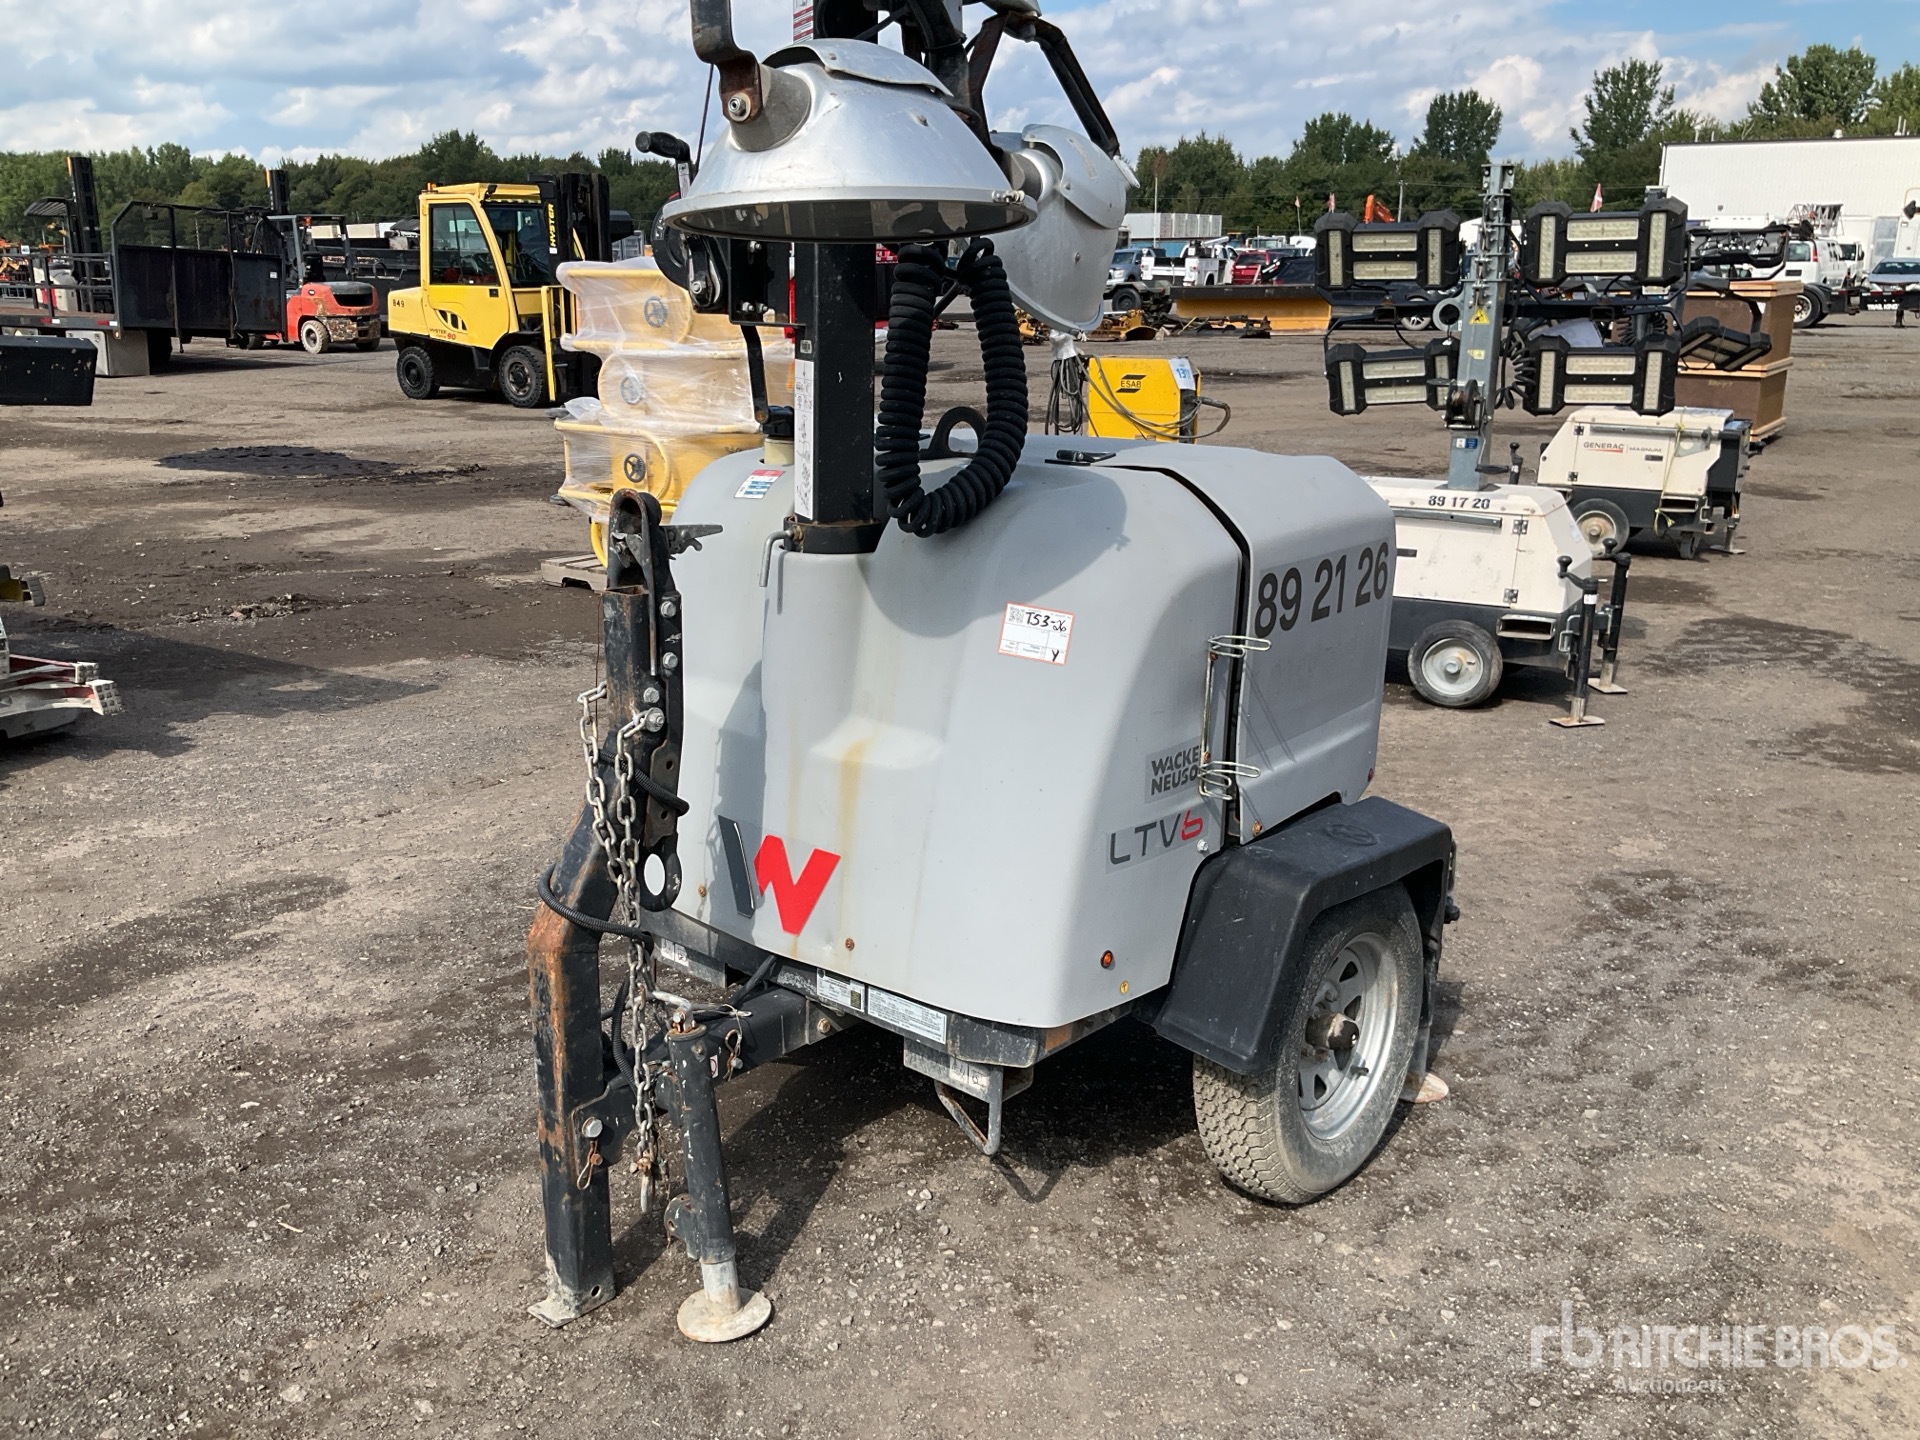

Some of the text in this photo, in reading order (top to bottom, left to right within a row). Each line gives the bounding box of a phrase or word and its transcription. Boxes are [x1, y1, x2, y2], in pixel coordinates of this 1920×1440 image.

[548, 203, 556, 247] HYSTER
[447, 332, 457, 341] 90
[1120, 380, 1142, 388] ESAB
[1583, 441, 1625, 450] GENERAC
[1428, 495, 1491, 510] 89 17 20
[1254, 541, 1389, 638] 89 21 26
[1151, 744, 1202, 777] WACKE
[1150, 764, 1200, 796] NEUSO
[1110, 808, 1203, 865] LTV6
